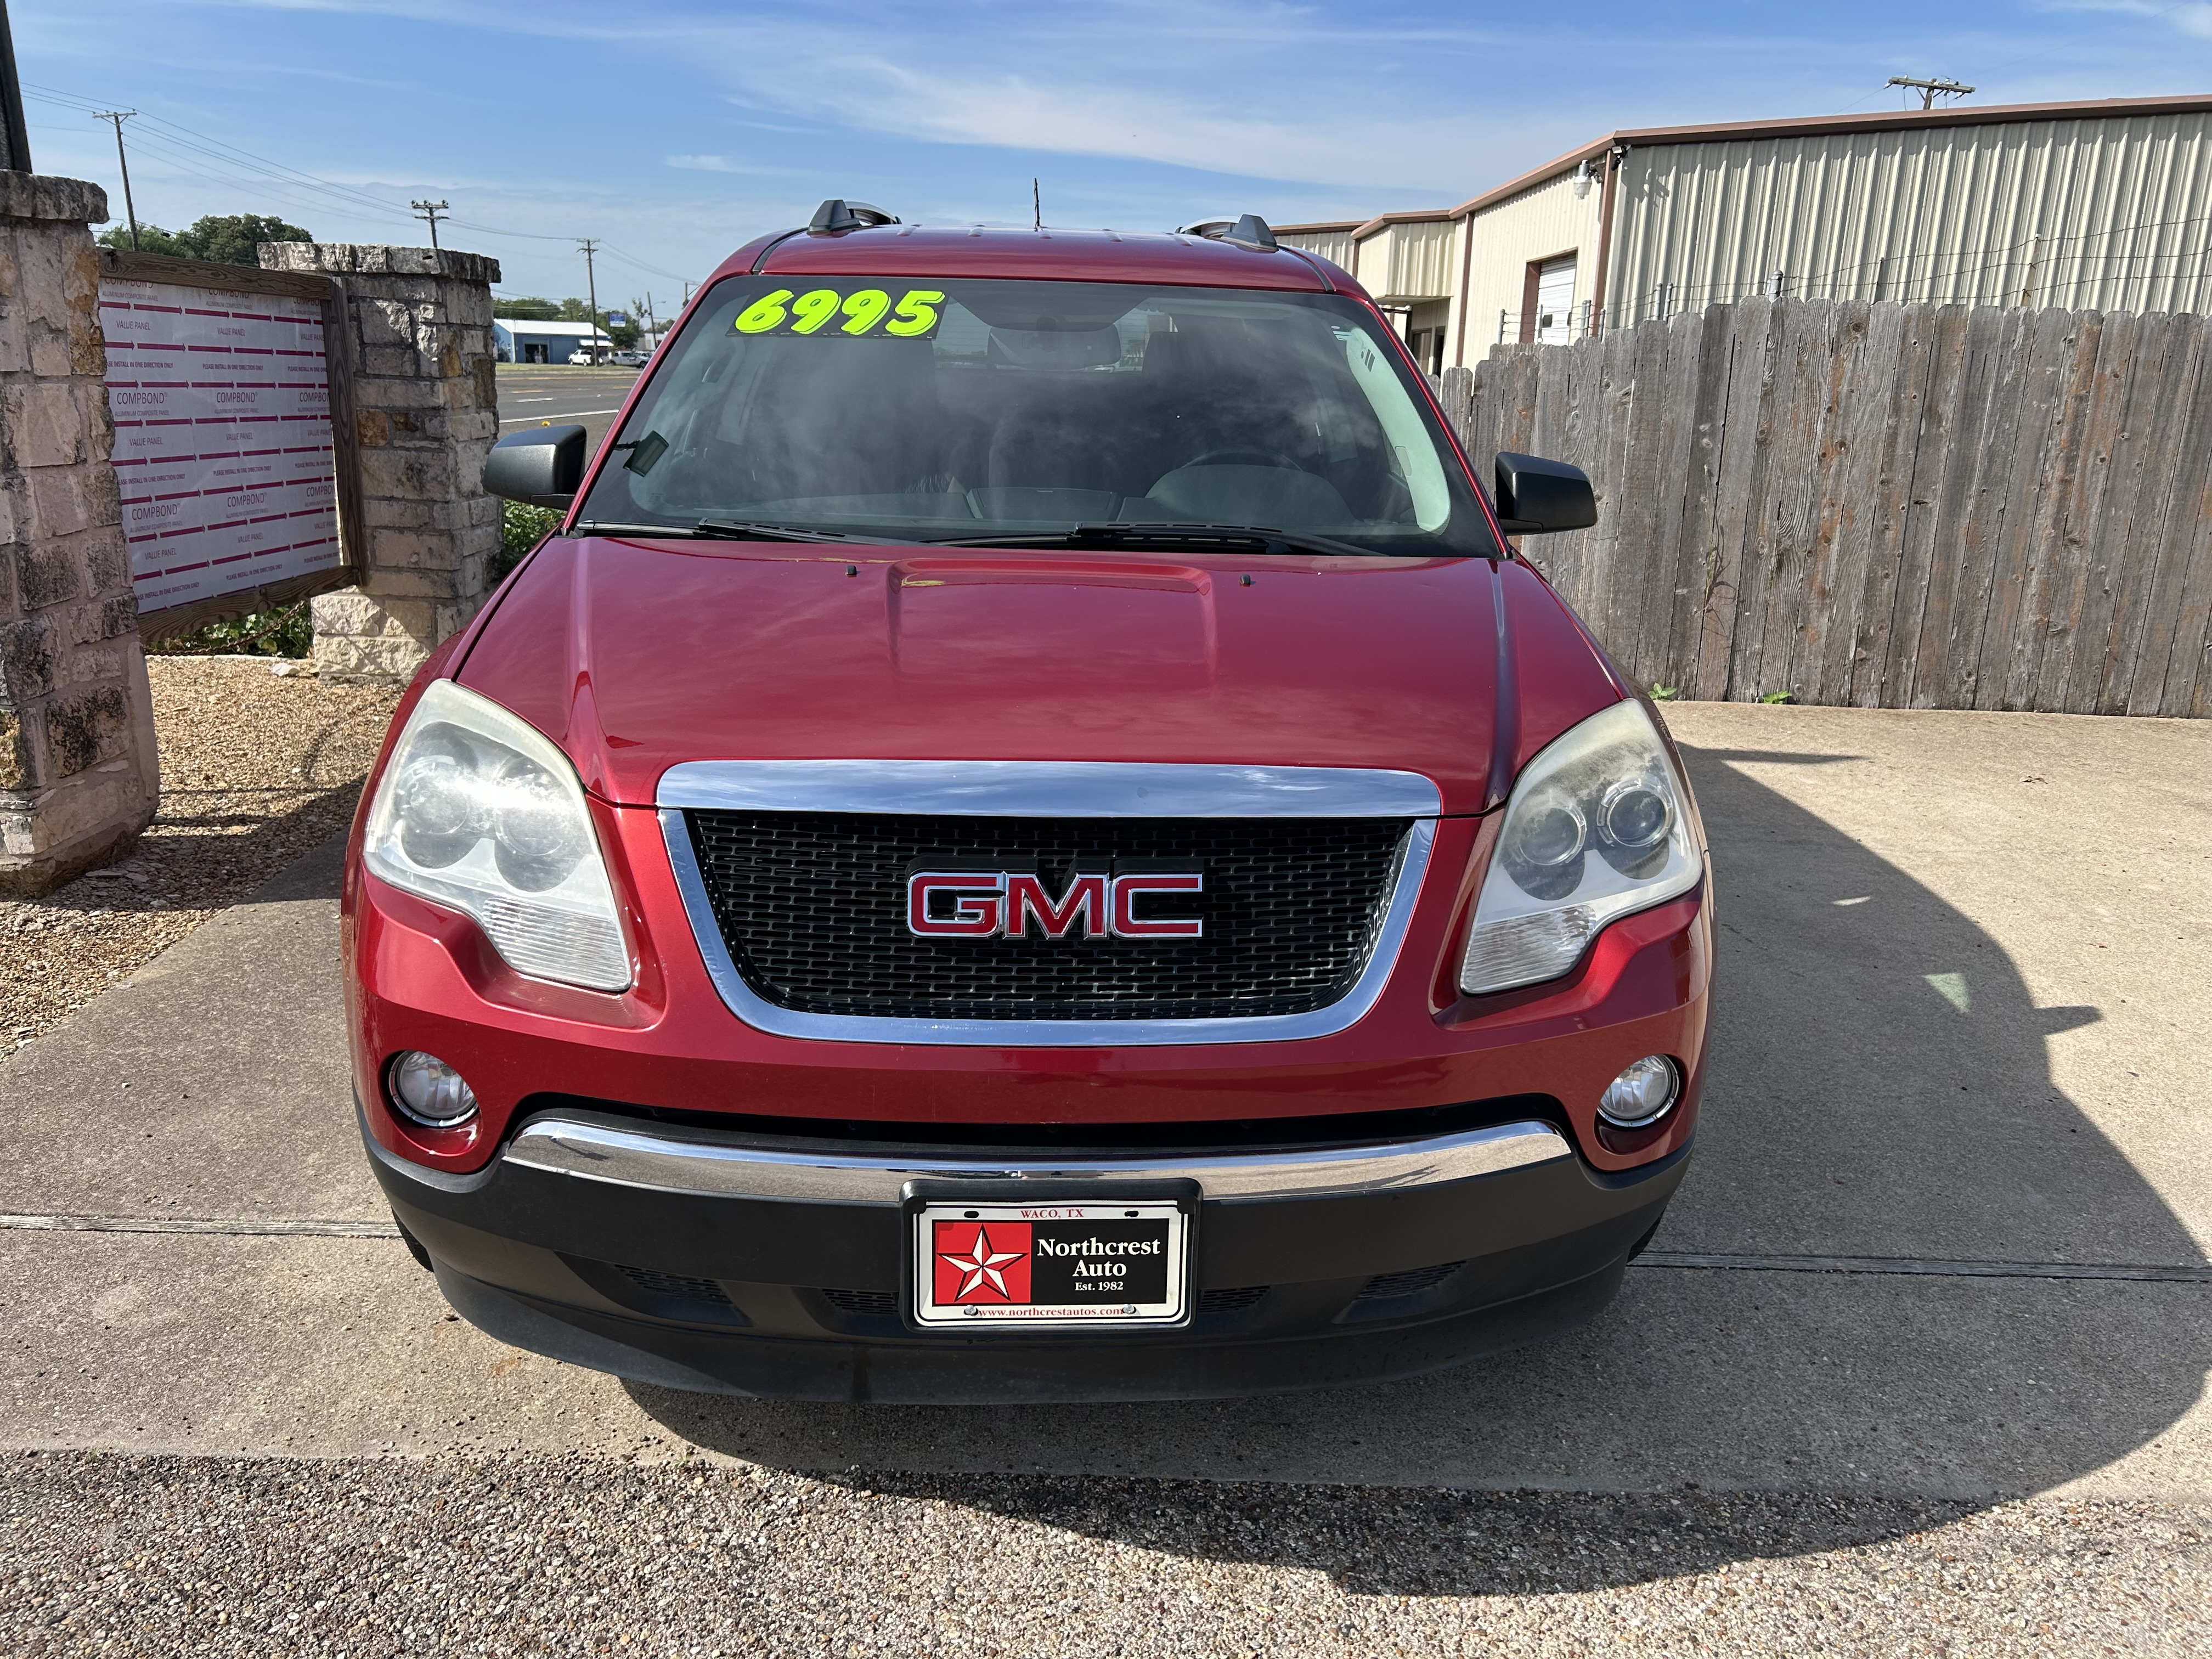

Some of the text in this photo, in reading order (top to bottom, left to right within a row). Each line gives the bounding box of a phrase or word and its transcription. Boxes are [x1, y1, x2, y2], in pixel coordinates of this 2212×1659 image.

[735, 290, 944, 336] 6995
[116, 320, 133, 329] VALUE
[129, 437, 163, 446] VALUE PANEL
[130, 525, 151, 533] ALUMINUM
[151, 522, 171, 532] COMPOSITE
[238, 532, 263, 543] VALUE PANEL
[145, 548, 177, 560] VALUE PANEL
[145, 590, 159, 599] INSTALL
[172, 584, 190, 593] DIRECTION
[907, 871, 1203, 940] GMC
[1020, 1209, 1084, 1220] WACO, TX
[1037, 1238, 1160, 1256] Northcrest
[1073, 1260, 1126, 1277] Auto
[1075, 1282, 1124, 1291] Est. 1982
[978, 1307, 1124, 1317] www.northcrestautos.com
